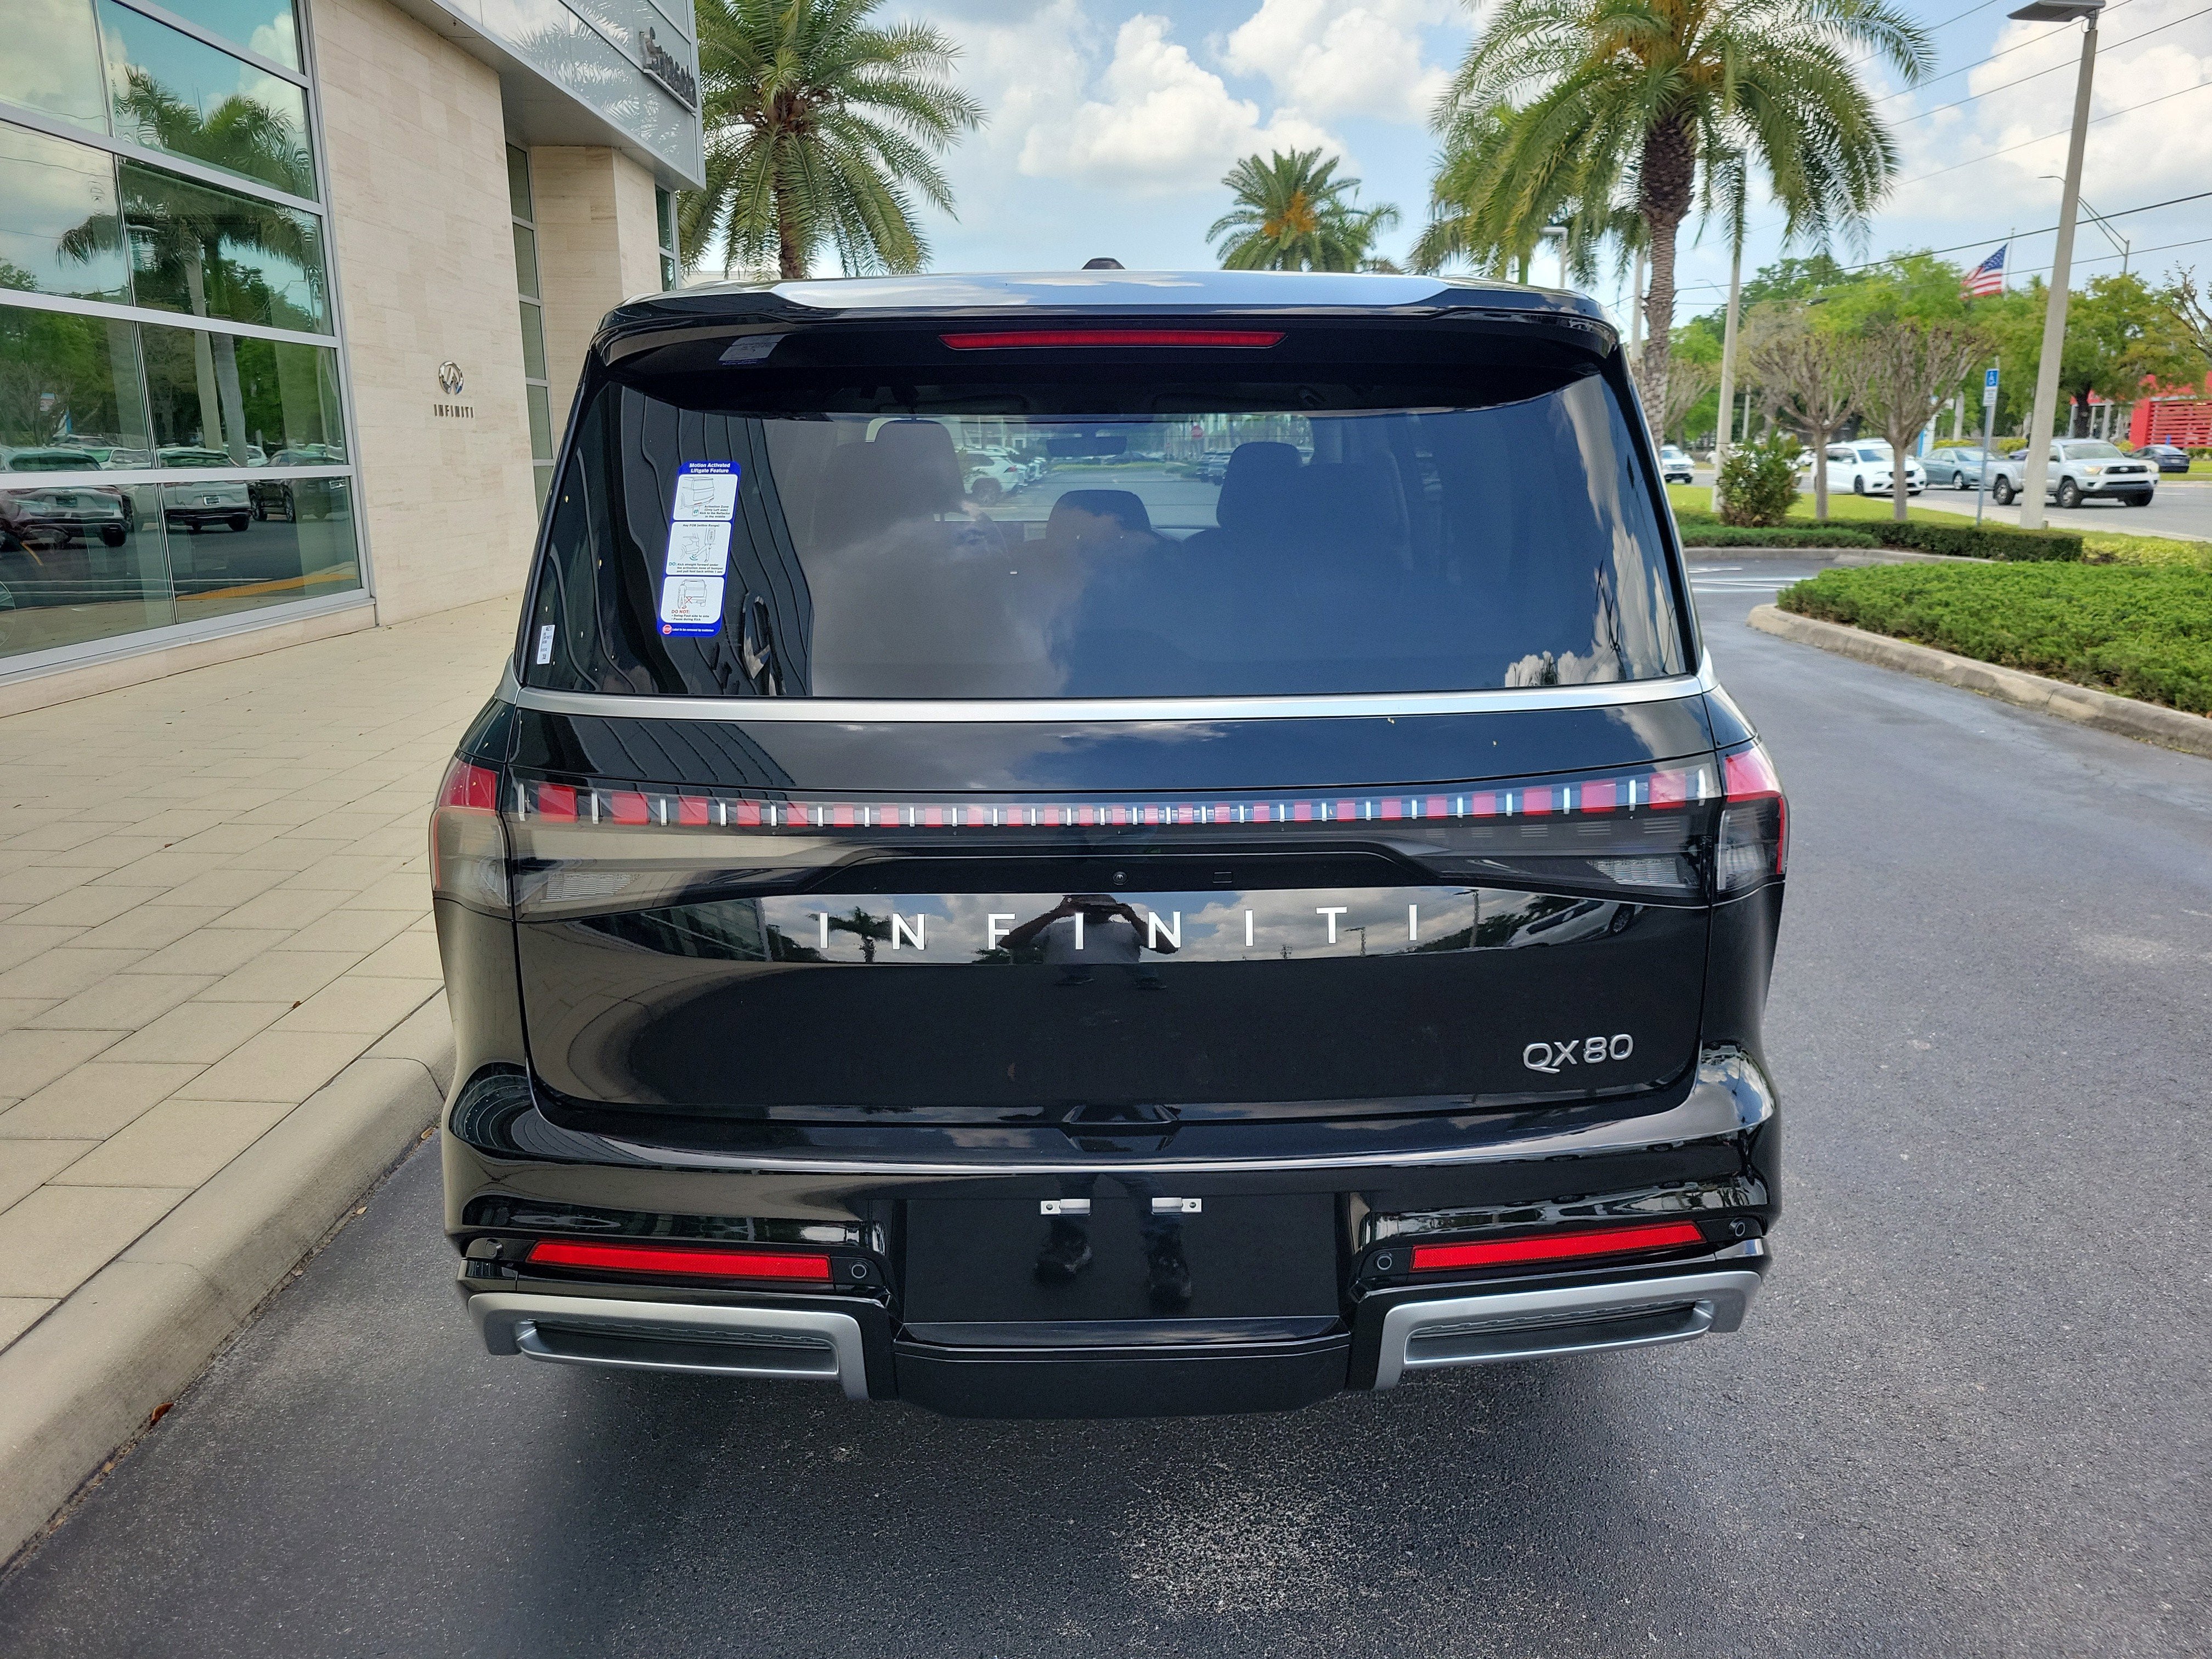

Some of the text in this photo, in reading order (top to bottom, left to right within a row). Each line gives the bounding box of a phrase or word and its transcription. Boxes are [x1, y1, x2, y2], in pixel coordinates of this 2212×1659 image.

[434, 404, 473, 418] INFINITI
[820, 904, 1418, 951] INFINITI
[1523, 1034, 1633, 1074] QX80
